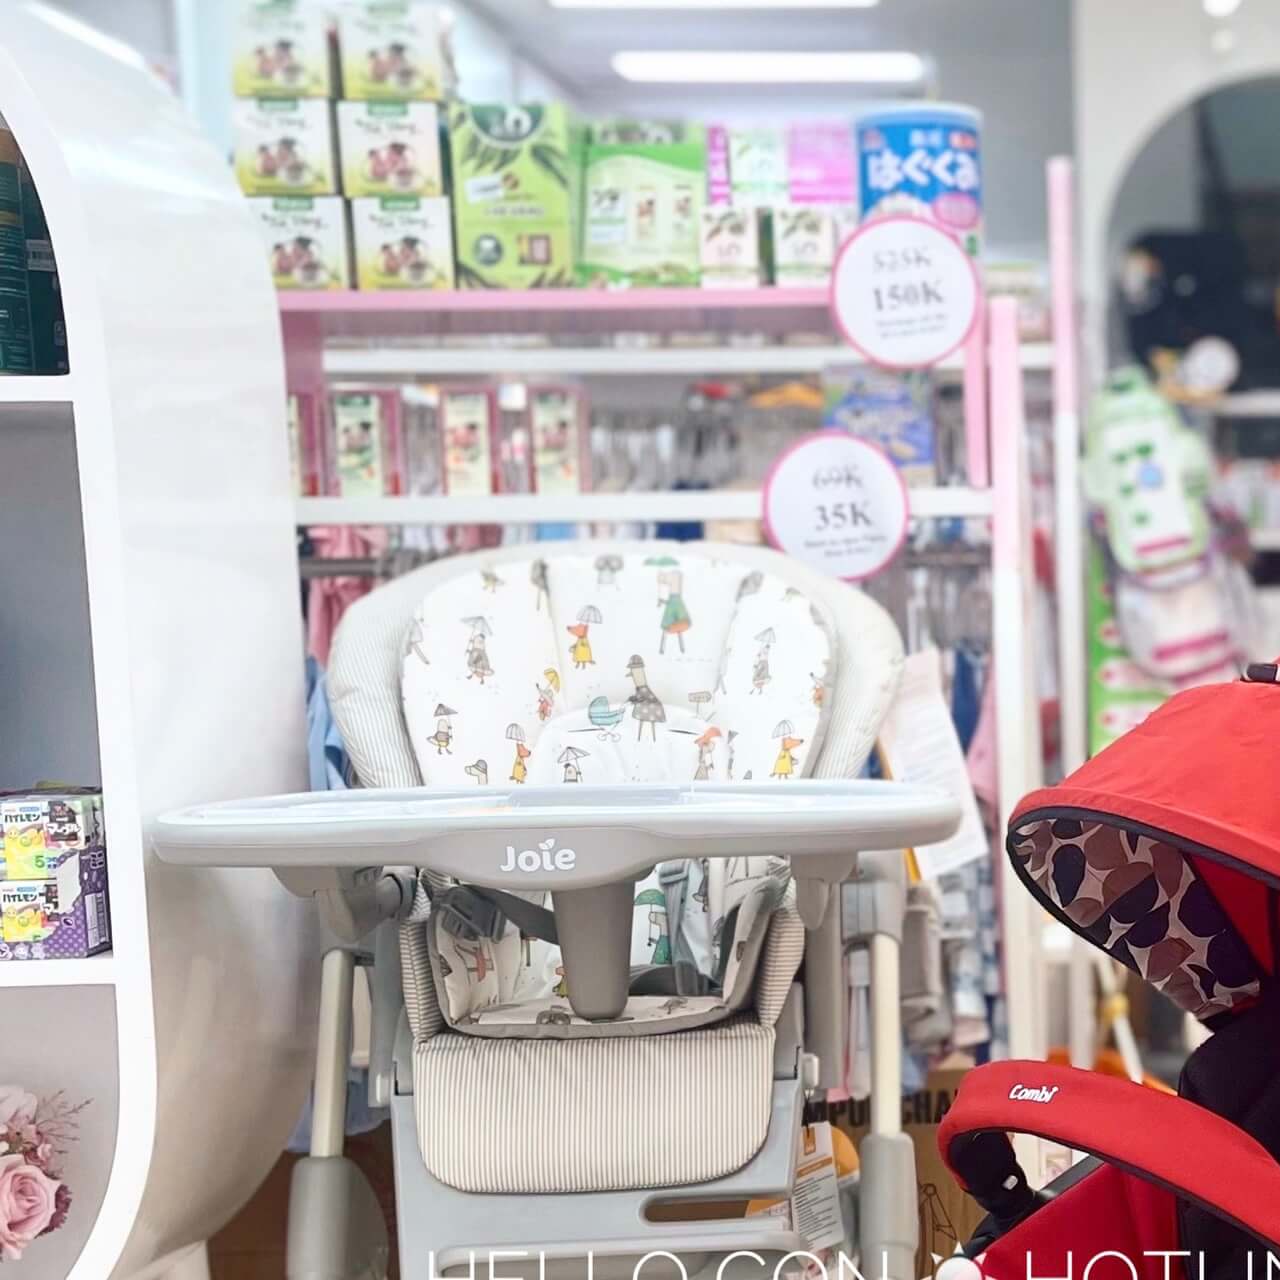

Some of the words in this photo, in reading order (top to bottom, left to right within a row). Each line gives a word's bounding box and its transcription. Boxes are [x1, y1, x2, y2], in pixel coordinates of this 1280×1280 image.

[873, 281, 944, 312] 150K
[815, 501, 873, 531] 35K
[34, 856, 45, 869] 5
[500, 838, 576, 872] Joie
[1009, 1084, 1059, 1103] Combi
